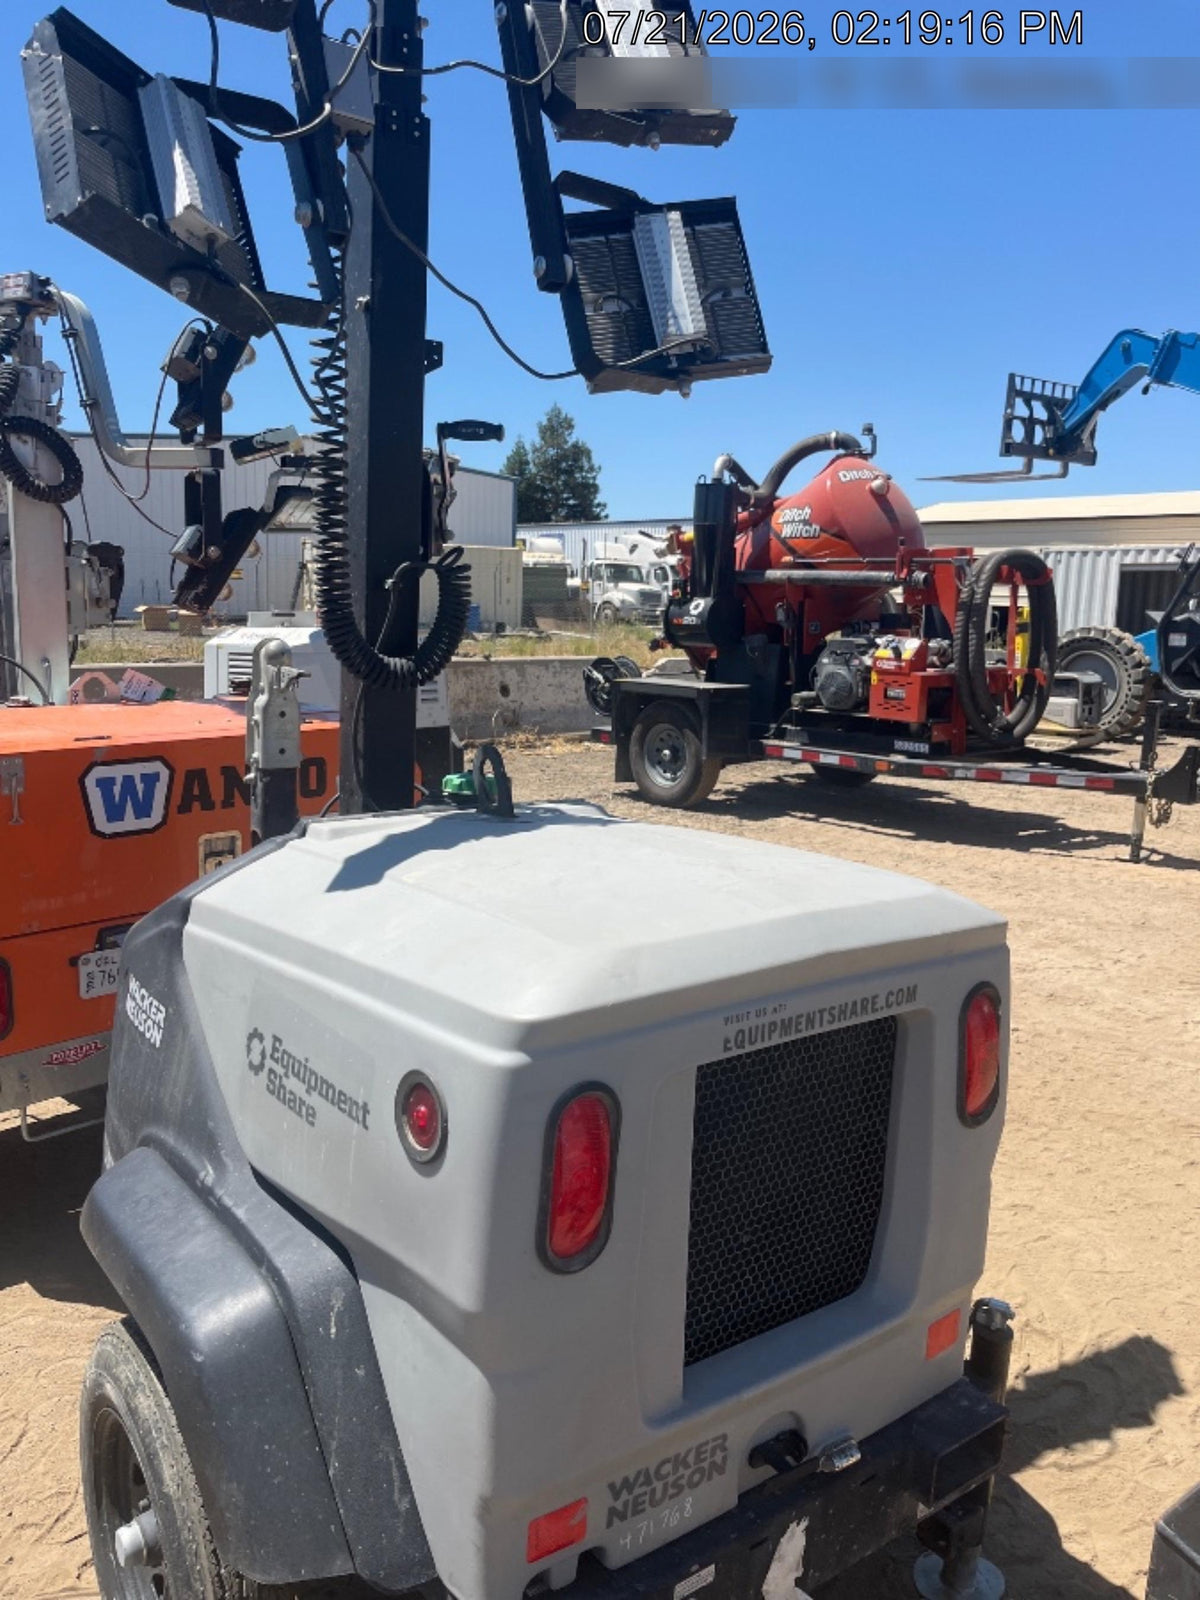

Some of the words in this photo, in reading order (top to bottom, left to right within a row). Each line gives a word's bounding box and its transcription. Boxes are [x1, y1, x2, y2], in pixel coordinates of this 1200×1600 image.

[778, 504, 811, 522] Ditch
[781, 522, 820, 538] Witch
[95, 757, 326, 823] WANO
[724, 1010, 750, 1026] VISIT
[755, 1007, 768, 1018] US
[266, 1067, 317, 1127] Share
[269, 1034, 371, 1131] Equipment
[606, 1455, 727, 1530] NEUSON
[607, 1433, 728, 1502] WACKER
